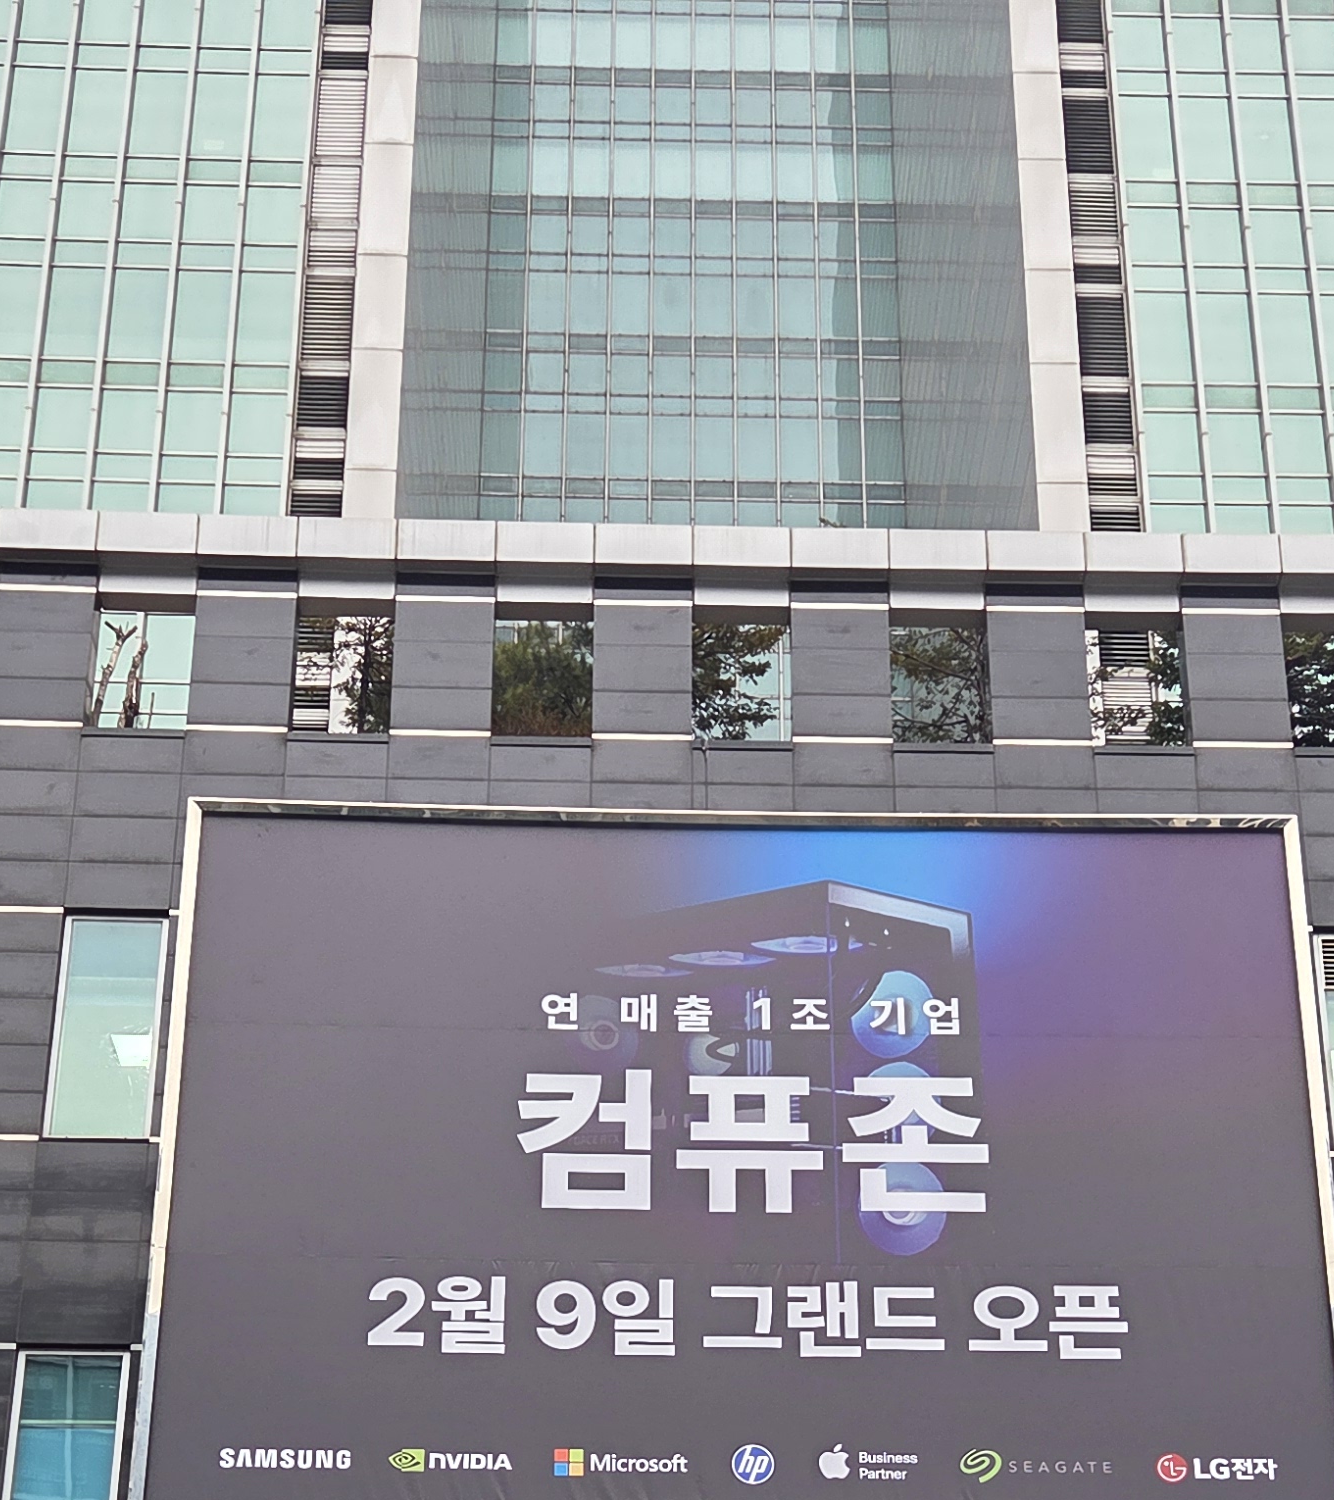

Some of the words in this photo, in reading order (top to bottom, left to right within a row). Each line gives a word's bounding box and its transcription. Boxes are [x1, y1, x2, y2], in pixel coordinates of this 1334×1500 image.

[540, 993, 581, 1031] 연
[619, 994, 714, 1033] 매출
[752, 997, 831, 1032] 1조
[869, 997, 961, 1035] 기업
[517, 1069, 989, 1214] 컴퓨존
[367, 1275, 507, 1355] 2월
[535, 1278, 676, 1357] 9일
[703, 1281, 946, 1359] 그랜드
[968, 1284, 1129, 1360] 오픈
[218, 1447, 352, 1470] SAMSUNG
[590, 1453, 689, 1474] Microsoft
[736, 1446, 771, 1483] hp
[858, 1451, 919, 1466] Business
[1008, 1460, 1113, 1474] SEAGATE
[1193, 1457, 1278, 1481] LG전자
[858, 1467, 908, 1482] Partner
